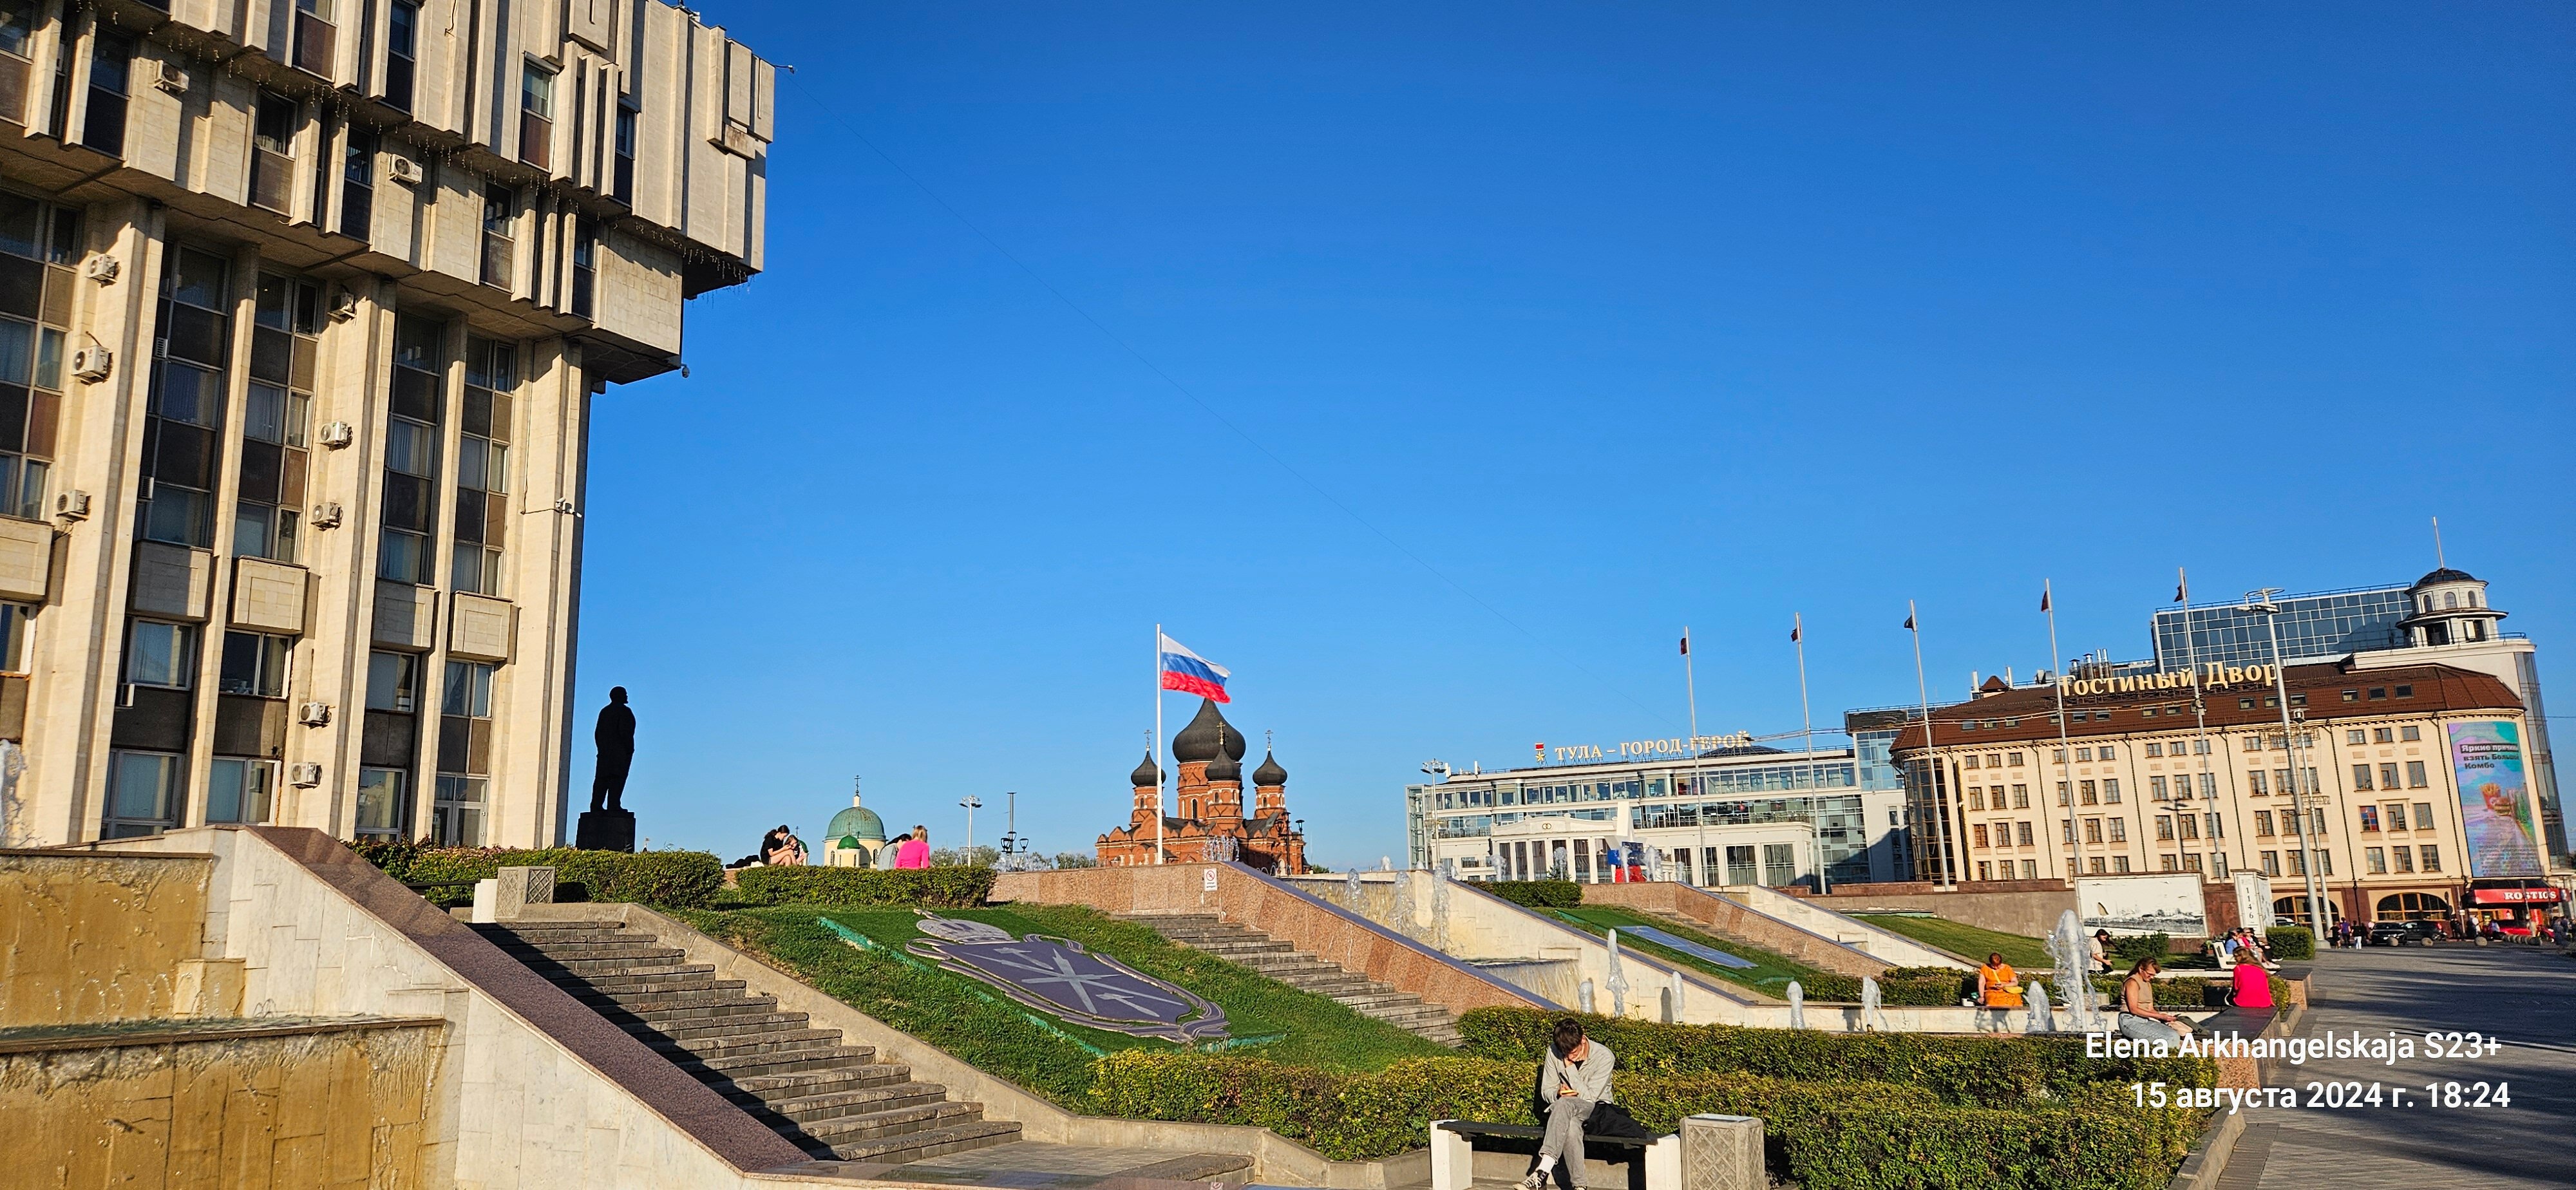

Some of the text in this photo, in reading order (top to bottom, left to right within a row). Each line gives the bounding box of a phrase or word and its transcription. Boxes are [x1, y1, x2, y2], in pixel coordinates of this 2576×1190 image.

[2058, 661, 2277, 696] Гостиный Двор
[1555, 745, 1603, 760] ТУЛА
[1620, 730, 1752, 756] ГОРОД-ГЕРОЙ
